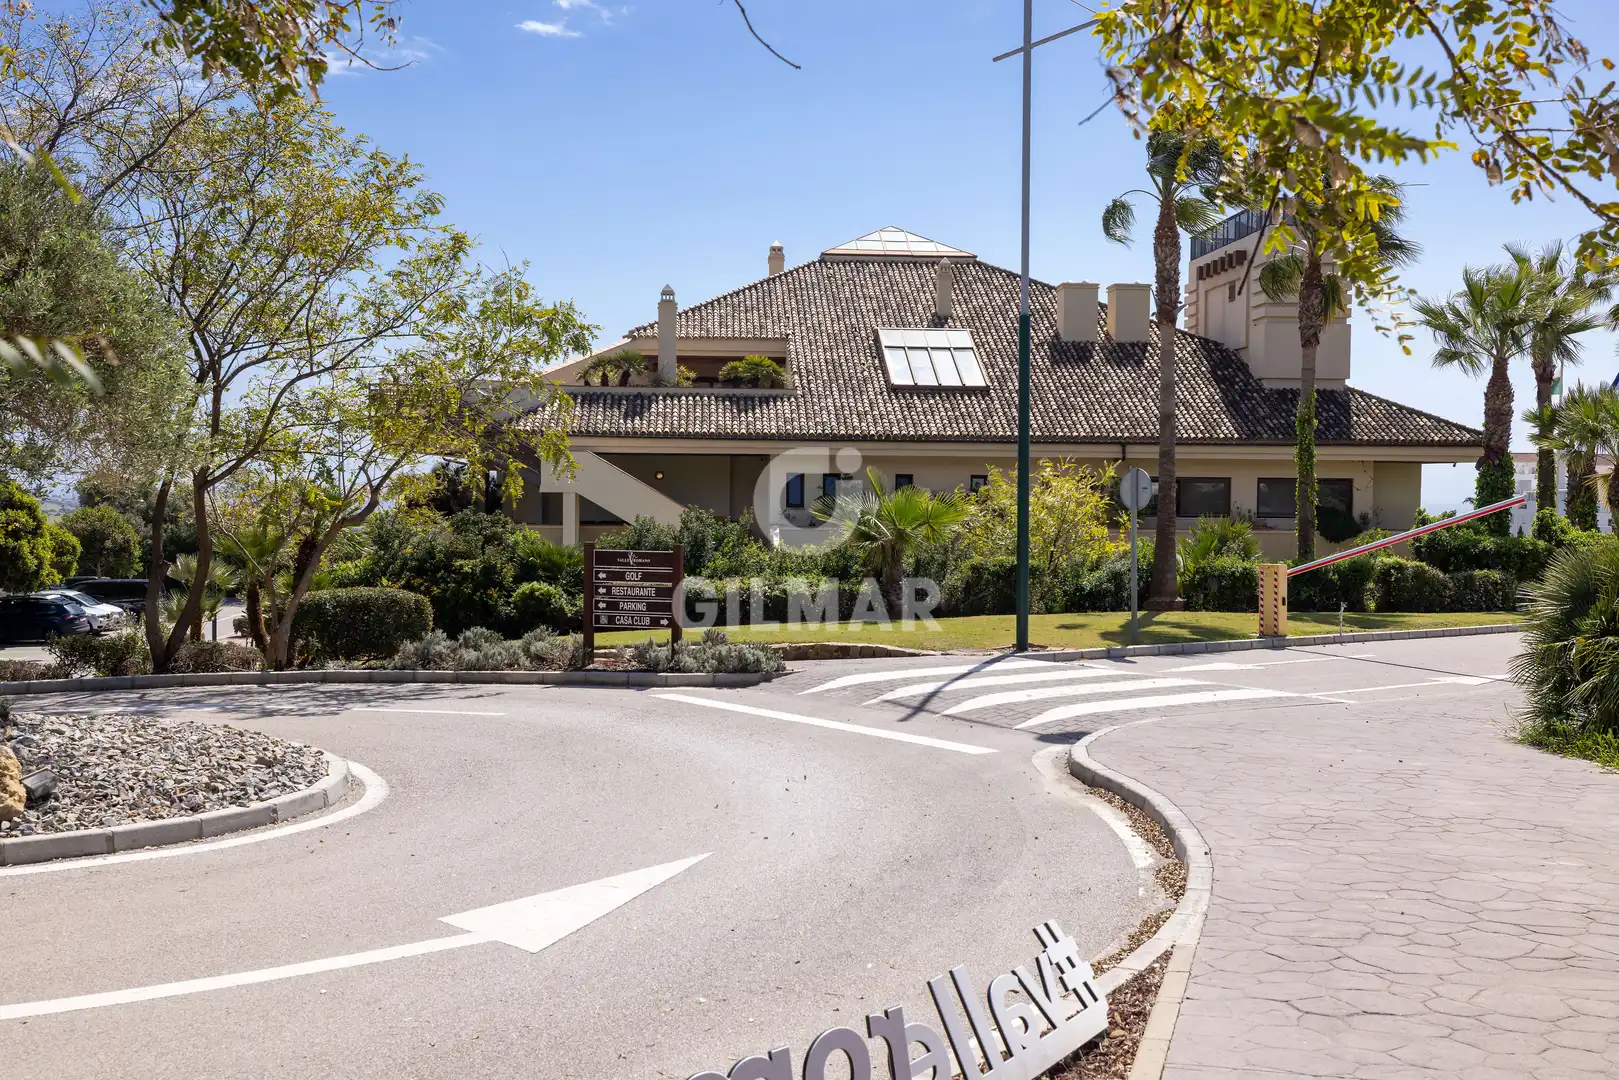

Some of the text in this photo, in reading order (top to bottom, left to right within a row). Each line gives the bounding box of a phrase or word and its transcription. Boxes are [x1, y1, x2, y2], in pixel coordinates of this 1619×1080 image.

[625, 572, 642, 580] GOLF
[612, 587, 655, 596] RESTAURANTE
[619, 602, 647, 611] PARKING
[615, 616, 650, 625] CASA CLUB
